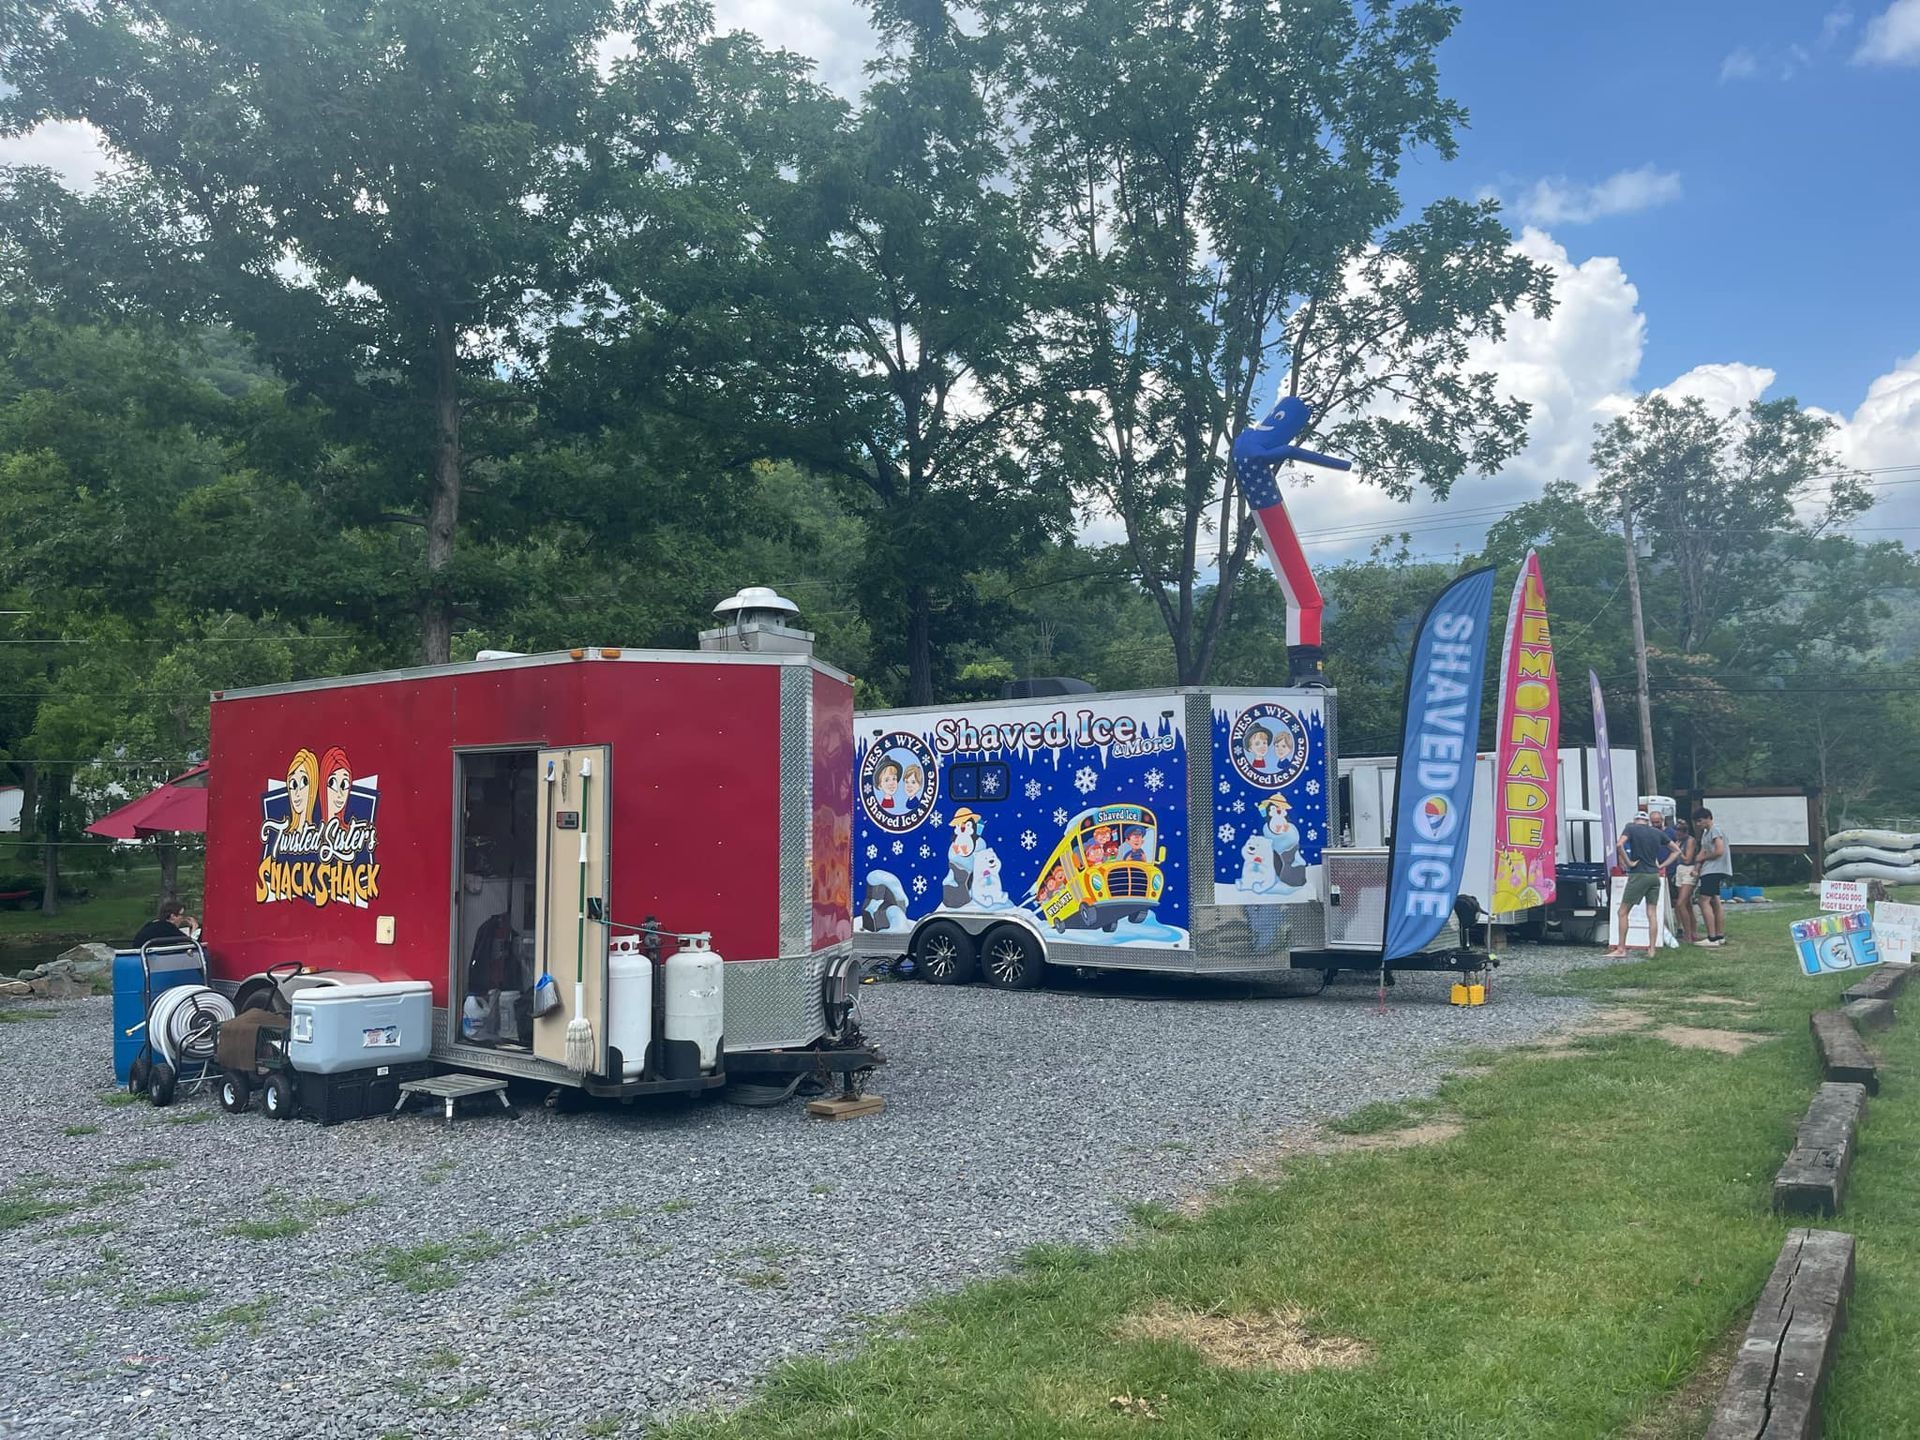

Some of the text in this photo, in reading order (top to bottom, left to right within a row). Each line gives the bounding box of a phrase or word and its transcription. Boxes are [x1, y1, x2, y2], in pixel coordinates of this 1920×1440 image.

[935, 710, 1137, 753] Shaved Ice
[1233, 705, 1292, 740] WES & WYZ
[1504, 574, 1552, 849] LEMONADE
[863, 735, 922, 776] WES & WYZ
[1114, 735, 1174, 756] & More
[1237, 757, 1271, 784] Shaved
[1273, 773, 1289, 784] Ice
[1293, 737, 1305, 770] More
[1405, 611, 1475, 918] SHAVED ICE
[866, 770, 935, 827] Shaved Ice & More
[1098, 809, 1137, 822] Shaved Ice
[261, 816, 322, 858] Twisted
[256, 856, 381, 908] SNACK SHACK
[1826, 892, 1850, 900] CHICAGO
[1831, 882, 1857, 891] HOT DOGS
[1791, 911, 1871, 940] SHAVED
[1799, 930, 1879, 975] ICE
